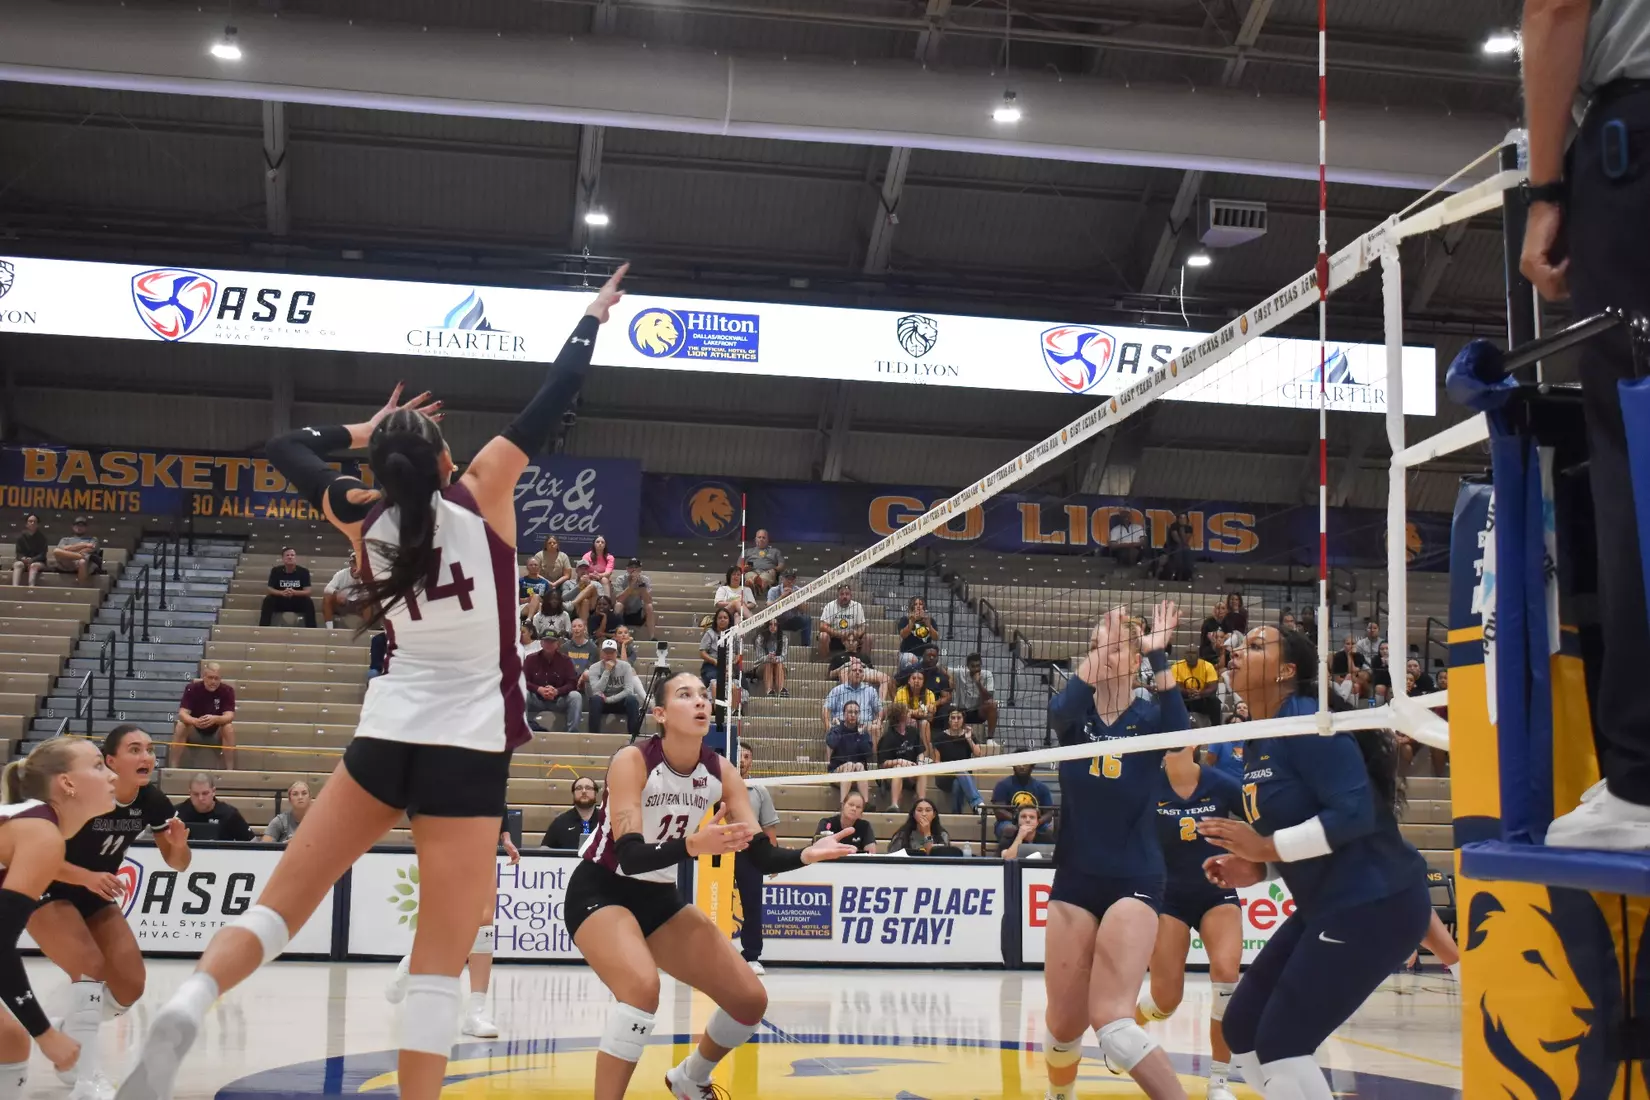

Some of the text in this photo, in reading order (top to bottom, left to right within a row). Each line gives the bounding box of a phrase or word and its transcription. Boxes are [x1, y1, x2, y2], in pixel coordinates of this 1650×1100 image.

[217, 287, 316, 324] ASG
[1253, 305, 1272, 325] EAST
[1274, 287, 1299, 313] TEXAS
[688, 313, 755, 333] Hilton
[406, 329, 526, 352] CHARTER
[1181, 349, 1197, 368] EAST
[1198, 335, 1220, 357] TEXAS
[710, 351, 757, 360] ATHLETICS
[873, 360, 959, 377] TED LYON
[1117, 342, 1191, 375] AS
[22, 447, 376, 494] BASKETB
[0, 485, 140, 513] TOURNAMENTS
[513, 465, 597, 511] Fix &
[220, 495, 326, 521] ALL-AMER
[522, 499, 603, 536] Feed
[868, 496, 985, 540] GO
[1017, 502, 1260, 553] LIONS
[1249, 768, 1273, 779] TEXAS
[1184, 805, 1216, 814] TEXAS
[92, 818, 142, 832] SALUKIS
[1179, 816, 1197, 841] 2
[100, 834, 125, 855] 11
[497, 863, 566, 890] Hunt
[141, 870, 256, 915] ASG
[762, 887, 828, 906] Hilton
[839, 886, 996, 915] BEST PLACE
[784, 929, 830, 937] ATHLETICS
[841, 917, 954, 945] TO STAY!
